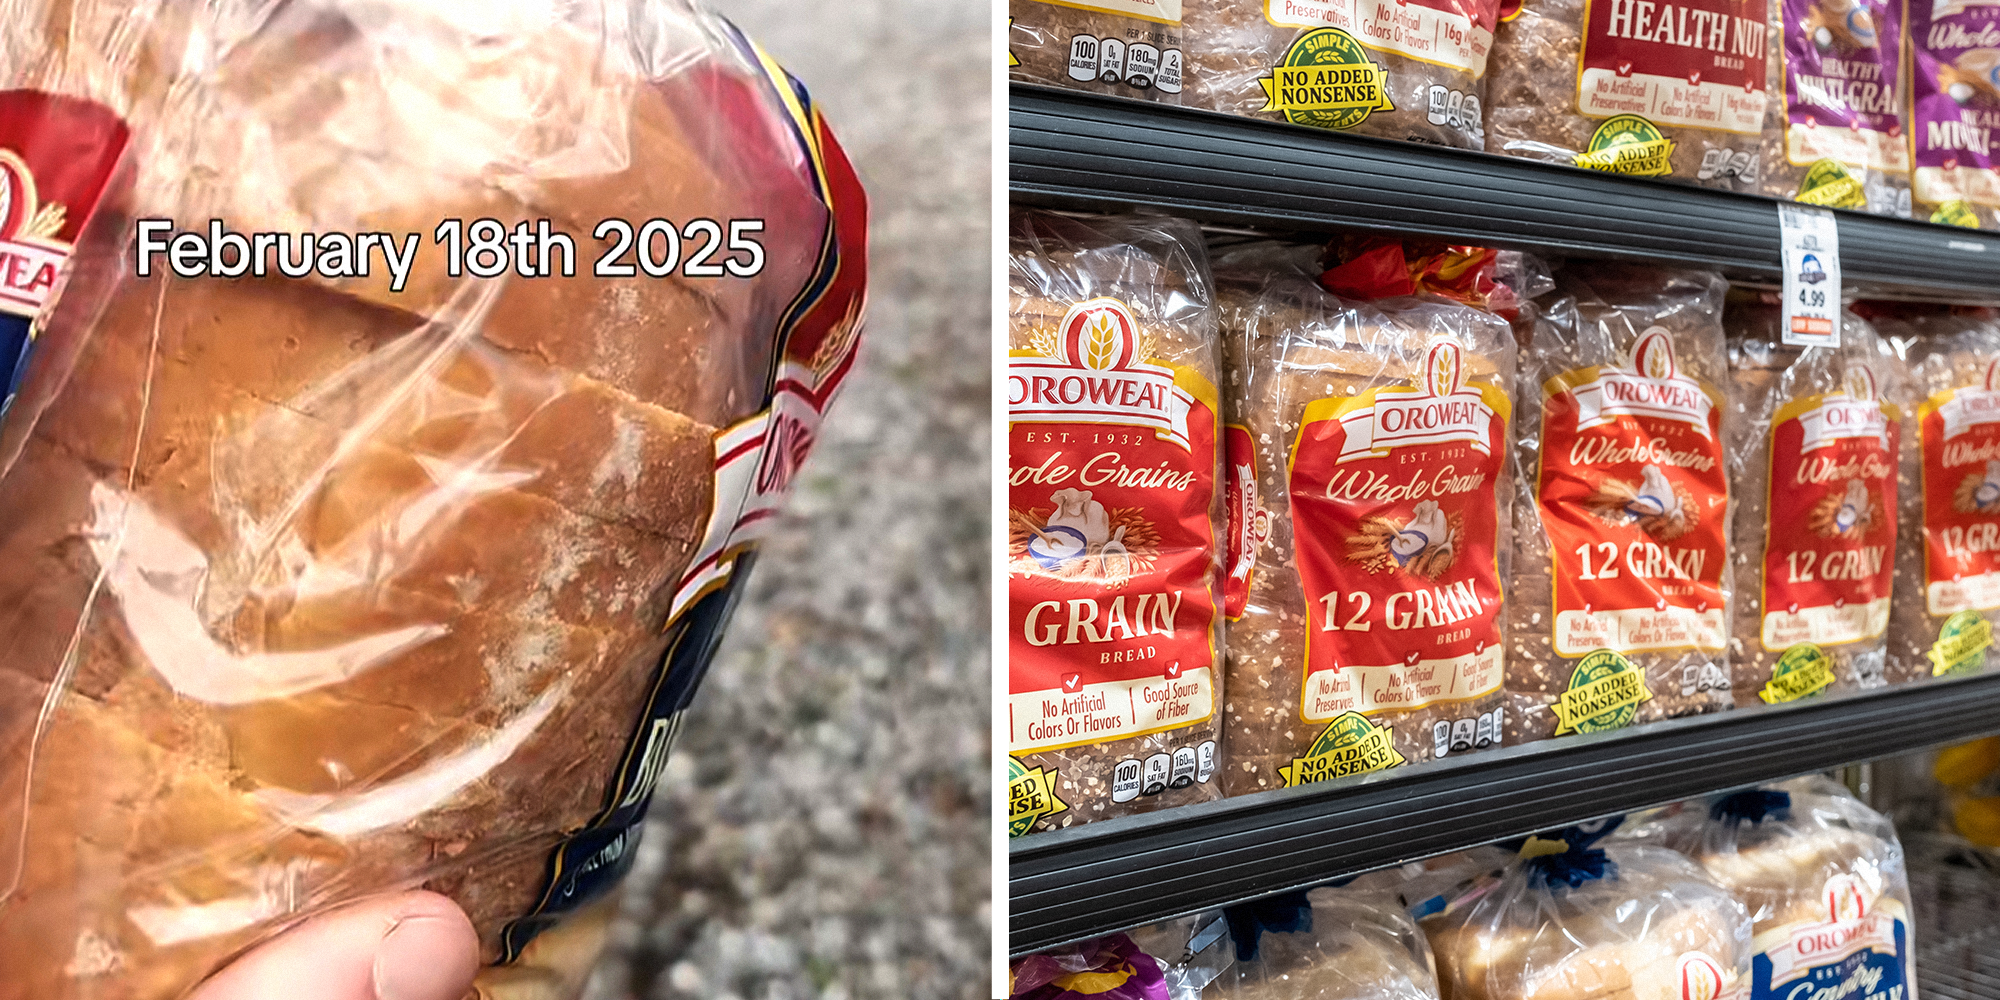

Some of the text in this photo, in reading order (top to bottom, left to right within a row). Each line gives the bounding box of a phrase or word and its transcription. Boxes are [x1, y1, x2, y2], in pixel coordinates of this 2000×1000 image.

[1286, 0, 1350, 28] Preservatives
[1377, 3, 1390, 21] No
[1126, 28, 1139, 40] PER
[1363, 18, 1391, 40] Colors
[1394, 26, 1403, 42] Or
[1445, 22, 1462, 46] 16g
[1607, 0, 1766, 60] HEALTH NUT
[1927, 21, 2000, 50] Whole
[1075, 41, 1096, 59] 100
[1305, 34, 1351, 54] SIMPLE
[1070, 59, 1096, 70] CALORIES
[1103, 60, 1120, 69] SAT FAT
[1129, 64, 1155, 74] SODIUM
[1164, 67, 1180, 78] TOTAL
[1714, 55, 1745, 71] BREAD
[1282, 69, 1374, 87] NO ADDED
[1597, 78, 1646, 97] No Artificial
[1282, 85, 1377, 105] NONSENSE
[1590, 93, 1646, 113] Preservatives
[1603, 120, 1643, 139] SIMPLE
[1618, 144, 1665, 162] ADDED
[1799, 289, 1825, 307] 4.99
[1604, 380, 1699, 410] OROWEAT
[1381, 401, 1476, 433] OROWEAT
[1027, 432, 1143, 446] EST. 1932
[1400, 448, 1466, 464] EST. 1932
[1569, 436, 1715, 472] Whole Grains
[1080, 452, 1197, 492] Grains
[1325, 468, 1430, 503] Whole
[1245, 483, 1255, 561] OROWEAT
[1575, 541, 1619, 581] 12
[1787, 550, 1817, 584] 12
[1319, 578, 1483, 632] 12 GRAIN
[1024, 590, 1182, 648] GRAIN
[1570, 618, 1581, 631] No
[1436, 628, 1471, 646] BREAD
[1100, 646, 1156, 664] BREAD
[1581, 653, 1617, 676] SIMPLE
[1389, 666, 1434, 688] No Artificial
[1143, 680, 1199, 704] Good Source
[1319, 679, 1329, 696] No
[1374, 683, 1441, 704] Colors Or Flavors
[1568, 671, 1637, 707] NO ADDED
[1042, 690, 1106, 718] No Artificial
[1156, 700, 1190, 721] of Fiber
[1569, 683, 1641, 721] NONSENSE
[1028, 713, 1122, 741] Colors Or Flavors
[1302, 734, 1381, 773] NO ADDED
[1118, 764, 1137, 782] 100
[1174, 766, 1193, 777] SODIUM
[1299, 747, 1388, 785] NONSENSE
[1114, 781, 1139, 793] CALORIES
[1147, 772, 1166, 783] SAT FAT
